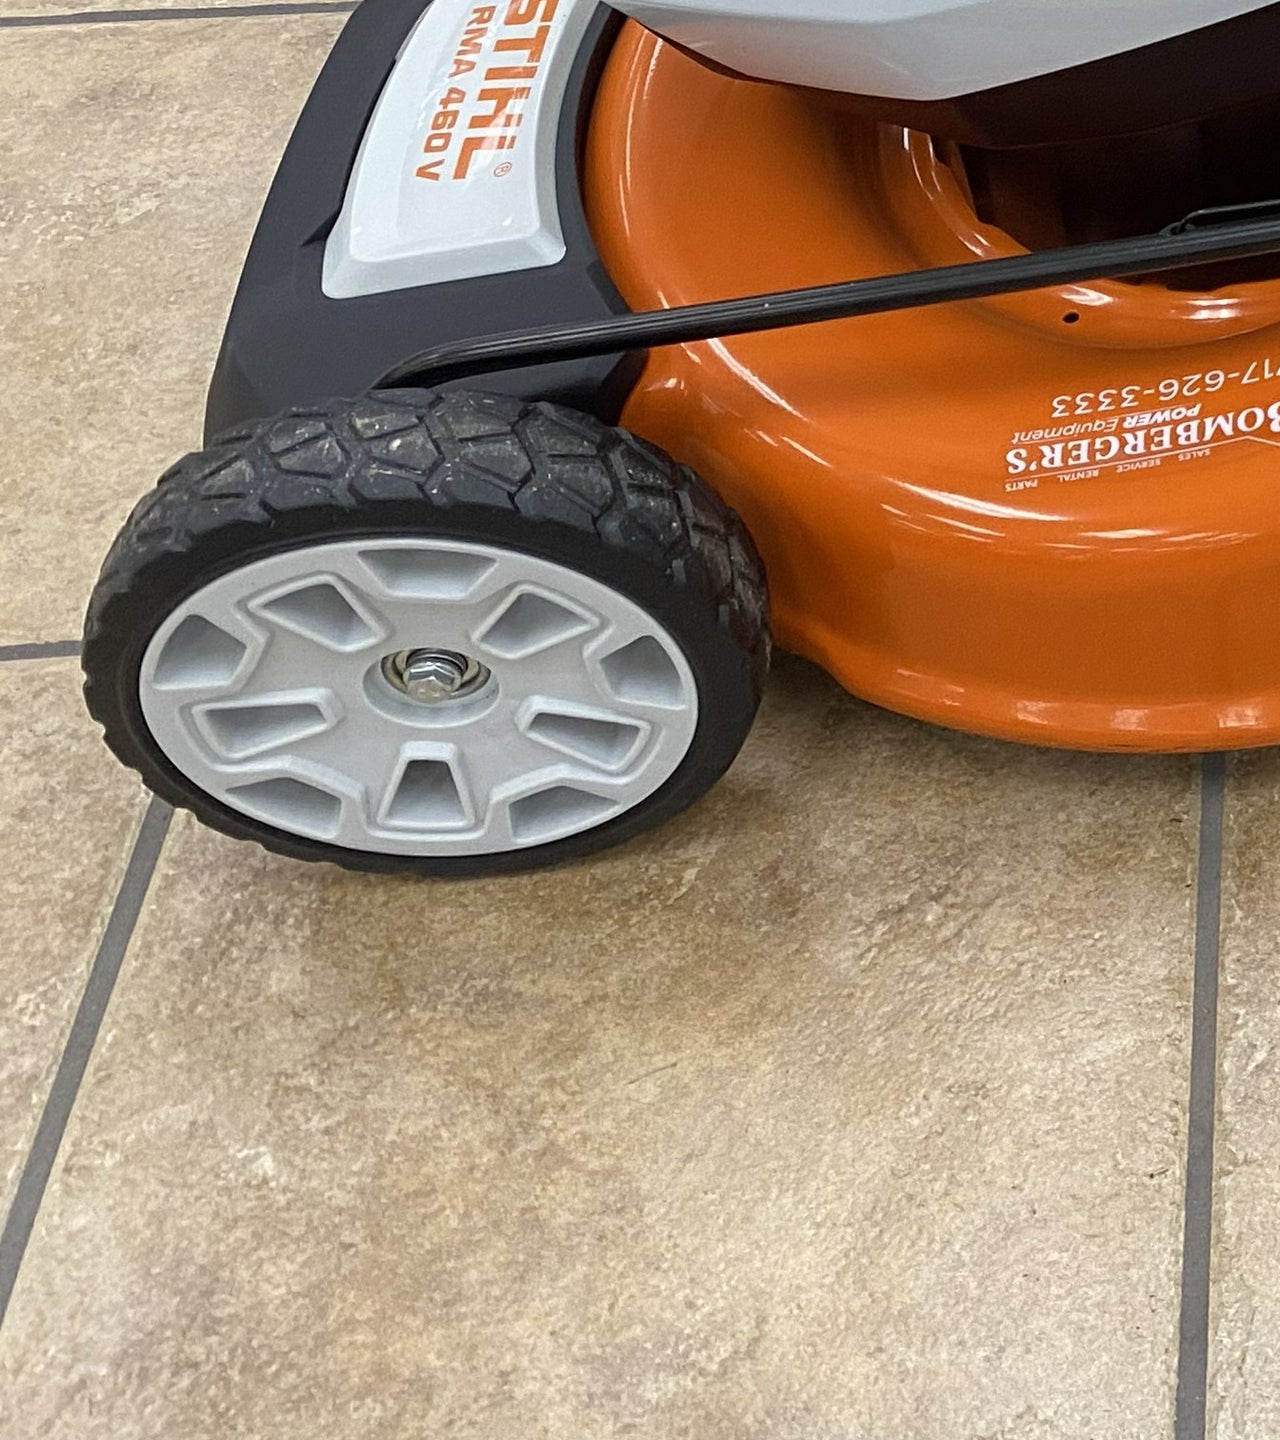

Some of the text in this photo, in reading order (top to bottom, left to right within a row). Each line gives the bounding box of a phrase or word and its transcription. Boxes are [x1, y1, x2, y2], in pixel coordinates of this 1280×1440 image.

[449, 5, 496, 78] RMA
[1012, 403, 1202, 444] POWER Equipment
[1005, 448, 1210, 492] SALES SERVICE RENTAL PARTS
